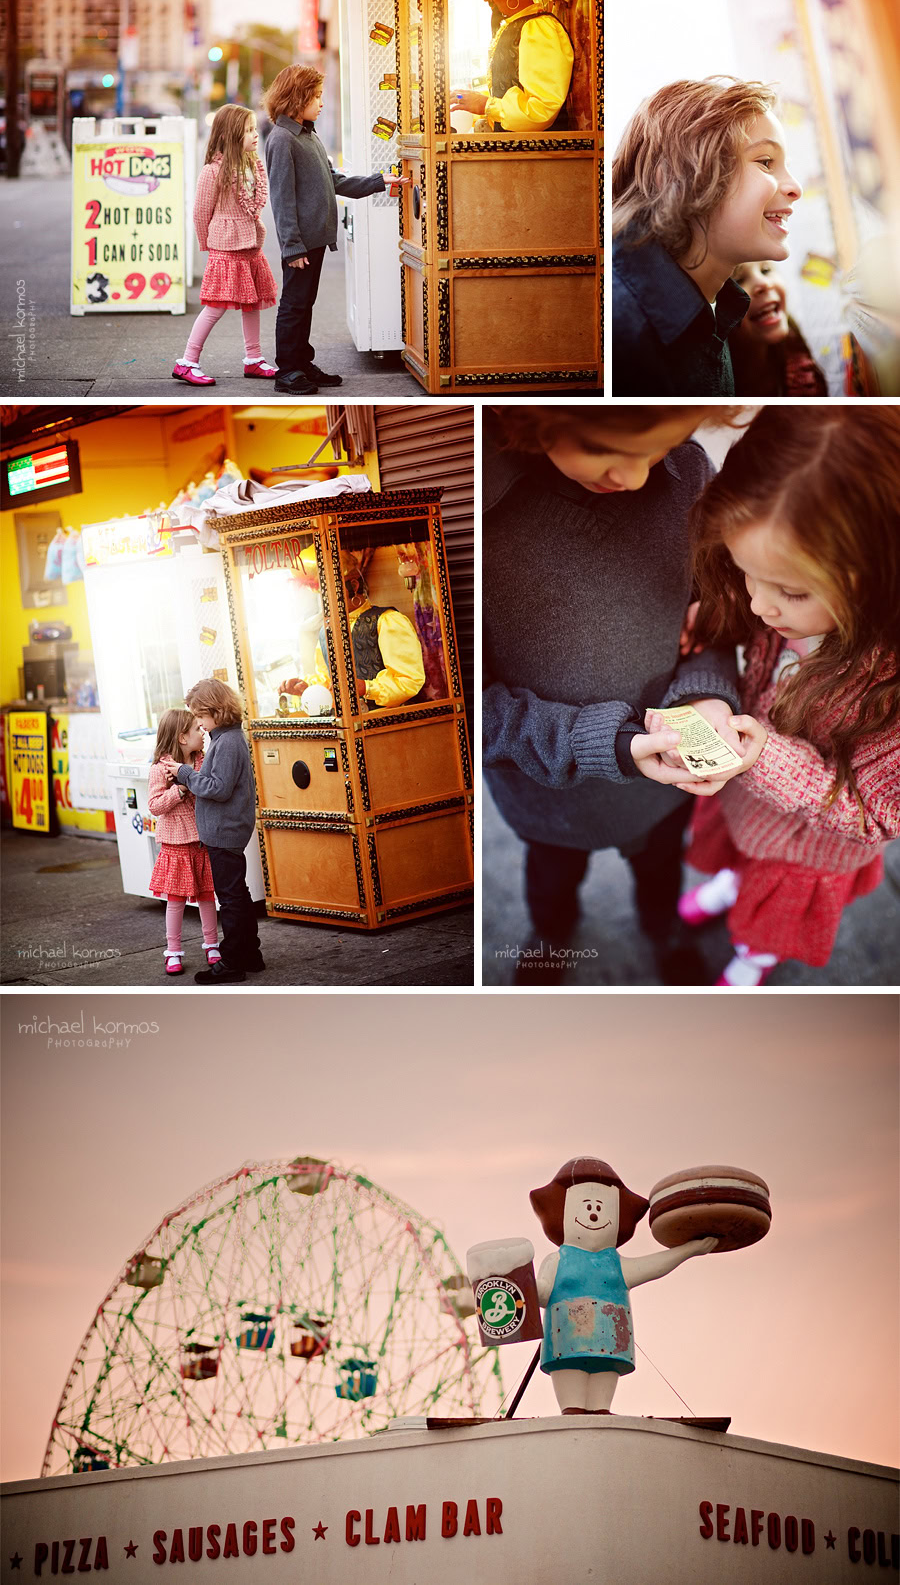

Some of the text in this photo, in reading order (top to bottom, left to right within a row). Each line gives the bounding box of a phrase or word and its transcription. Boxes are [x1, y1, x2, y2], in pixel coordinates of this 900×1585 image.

[90, 156, 171, 178] HOT DOGS
[85, 199, 172, 230] 2 HOT DOGS
[84, 237, 178, 266] 1 CAN OF SODA
[86, 272, 172, 304] 3.99
[245, 538, 308, 580] ZOLTAR
[477, 1280, 517, 1300] BROOKLYN
[481, 1315, 520, 1336] BREWERY
[34, 1496, 504, 1576] PIZZA SAUSAGES CLAM BAR
[699, 1500, 816, 1555] SEAFOOD
